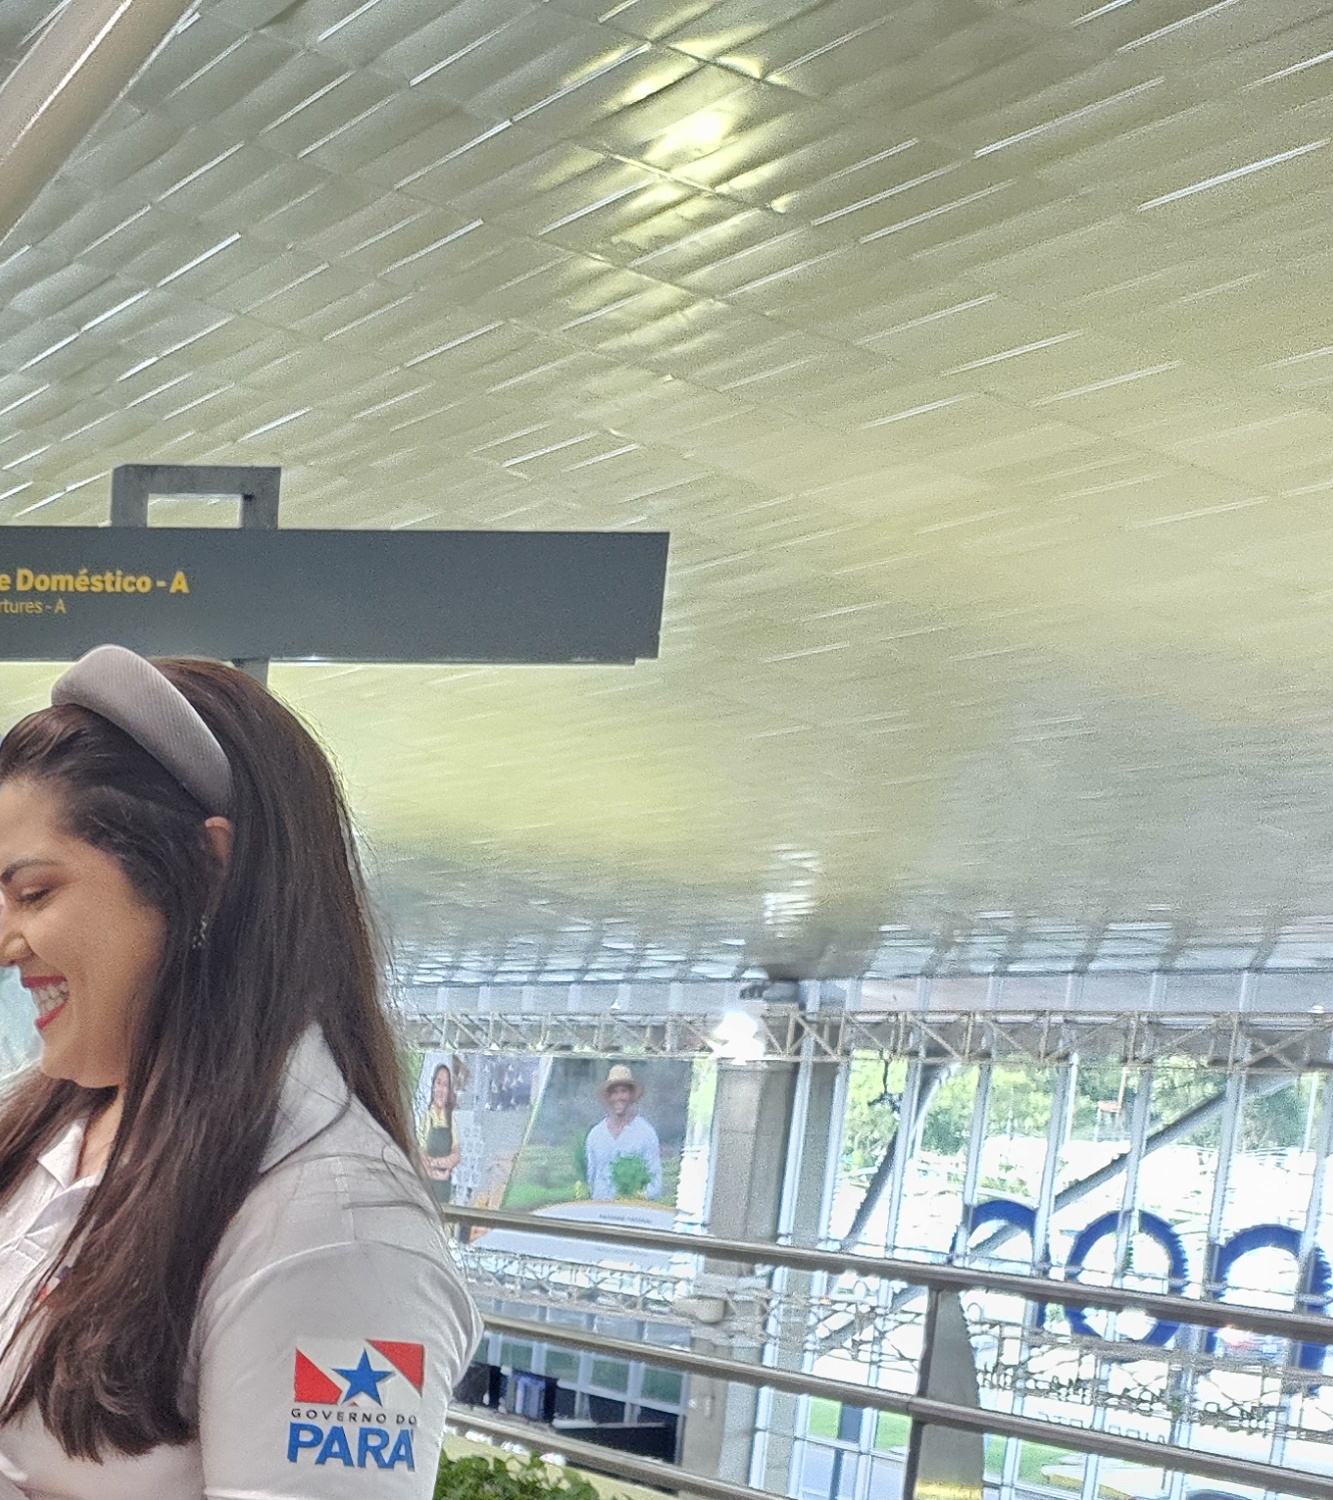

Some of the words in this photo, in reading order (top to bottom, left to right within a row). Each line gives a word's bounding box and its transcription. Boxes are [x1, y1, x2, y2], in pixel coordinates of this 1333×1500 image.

[17, 568, 153, 593] Doméstico
[169, 571, 190, 594] A
[54, 598, 67, 614] A
[291, 1408, 387, 1425] GOVERNO
[395, 1414, 418, 1425] DO
[287, 1421, 416, 1472] PARÁ
